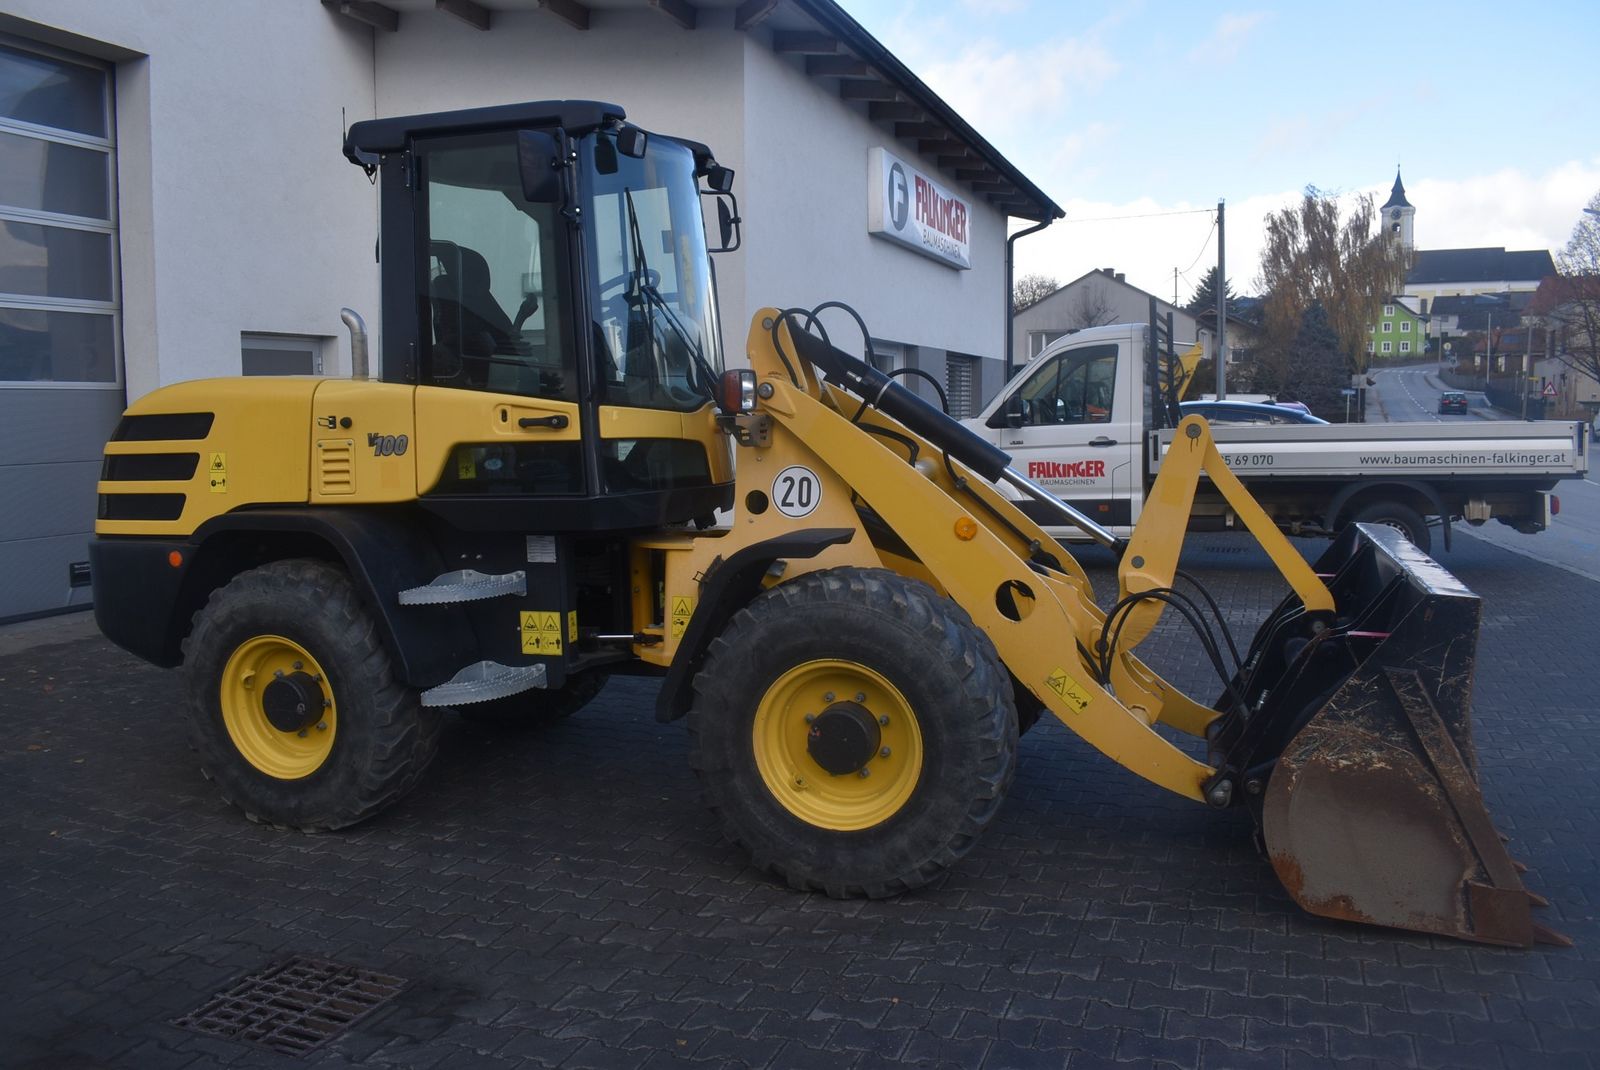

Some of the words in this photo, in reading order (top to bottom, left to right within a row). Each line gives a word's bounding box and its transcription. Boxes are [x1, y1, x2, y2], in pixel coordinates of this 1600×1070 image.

[915, 174, 967, 245] FALKINGER
[367, 432, 408, 456] V100
[1028, 460, 1105, 478] FALKINGER
[1235, 455, 1248, 465] 69
[1252, 455, 1274, 465] 070
[1360, 452, 1566, 466] www.baumaschinen-falkinger.at
[781, 476, 812, 508] 20
